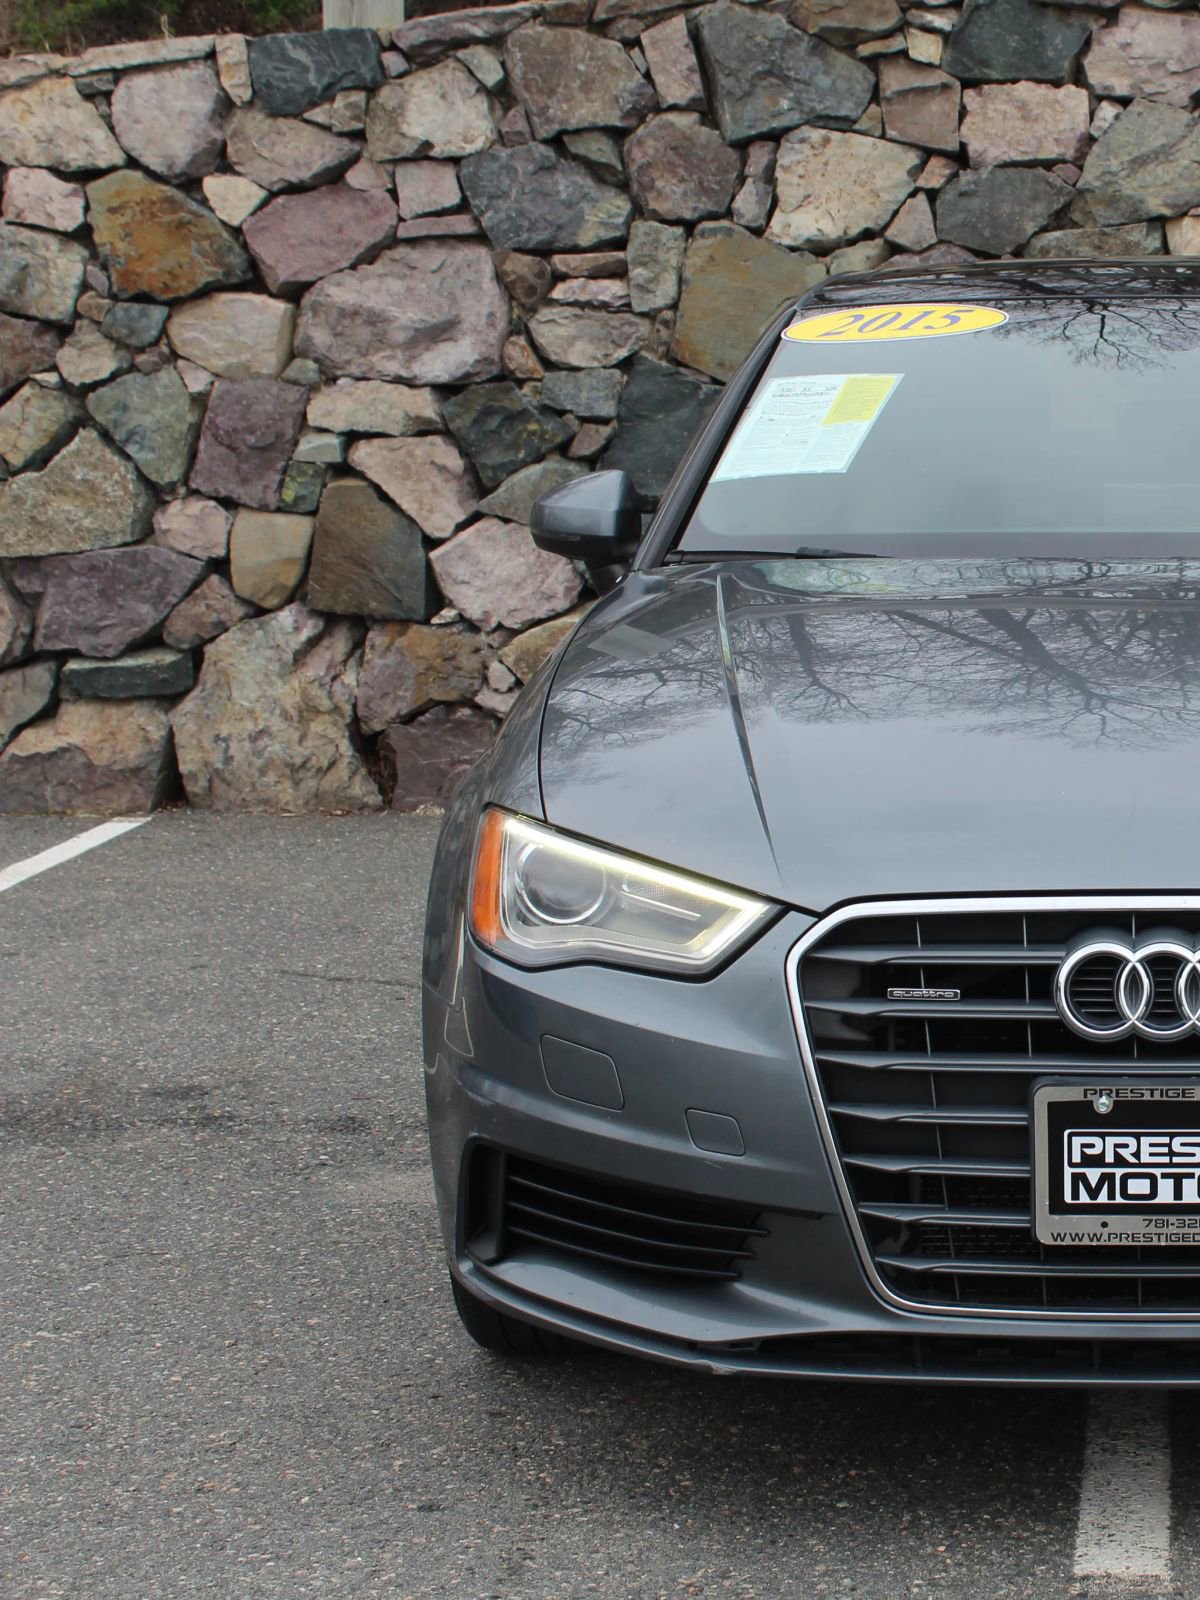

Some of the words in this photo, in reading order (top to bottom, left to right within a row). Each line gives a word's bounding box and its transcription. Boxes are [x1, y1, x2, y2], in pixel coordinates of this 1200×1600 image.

[816, 309, 976, 338] 2015
[892, 990, 954, 998] quattro
[1083, 1088, 1195, 1099] PRESTIGE
